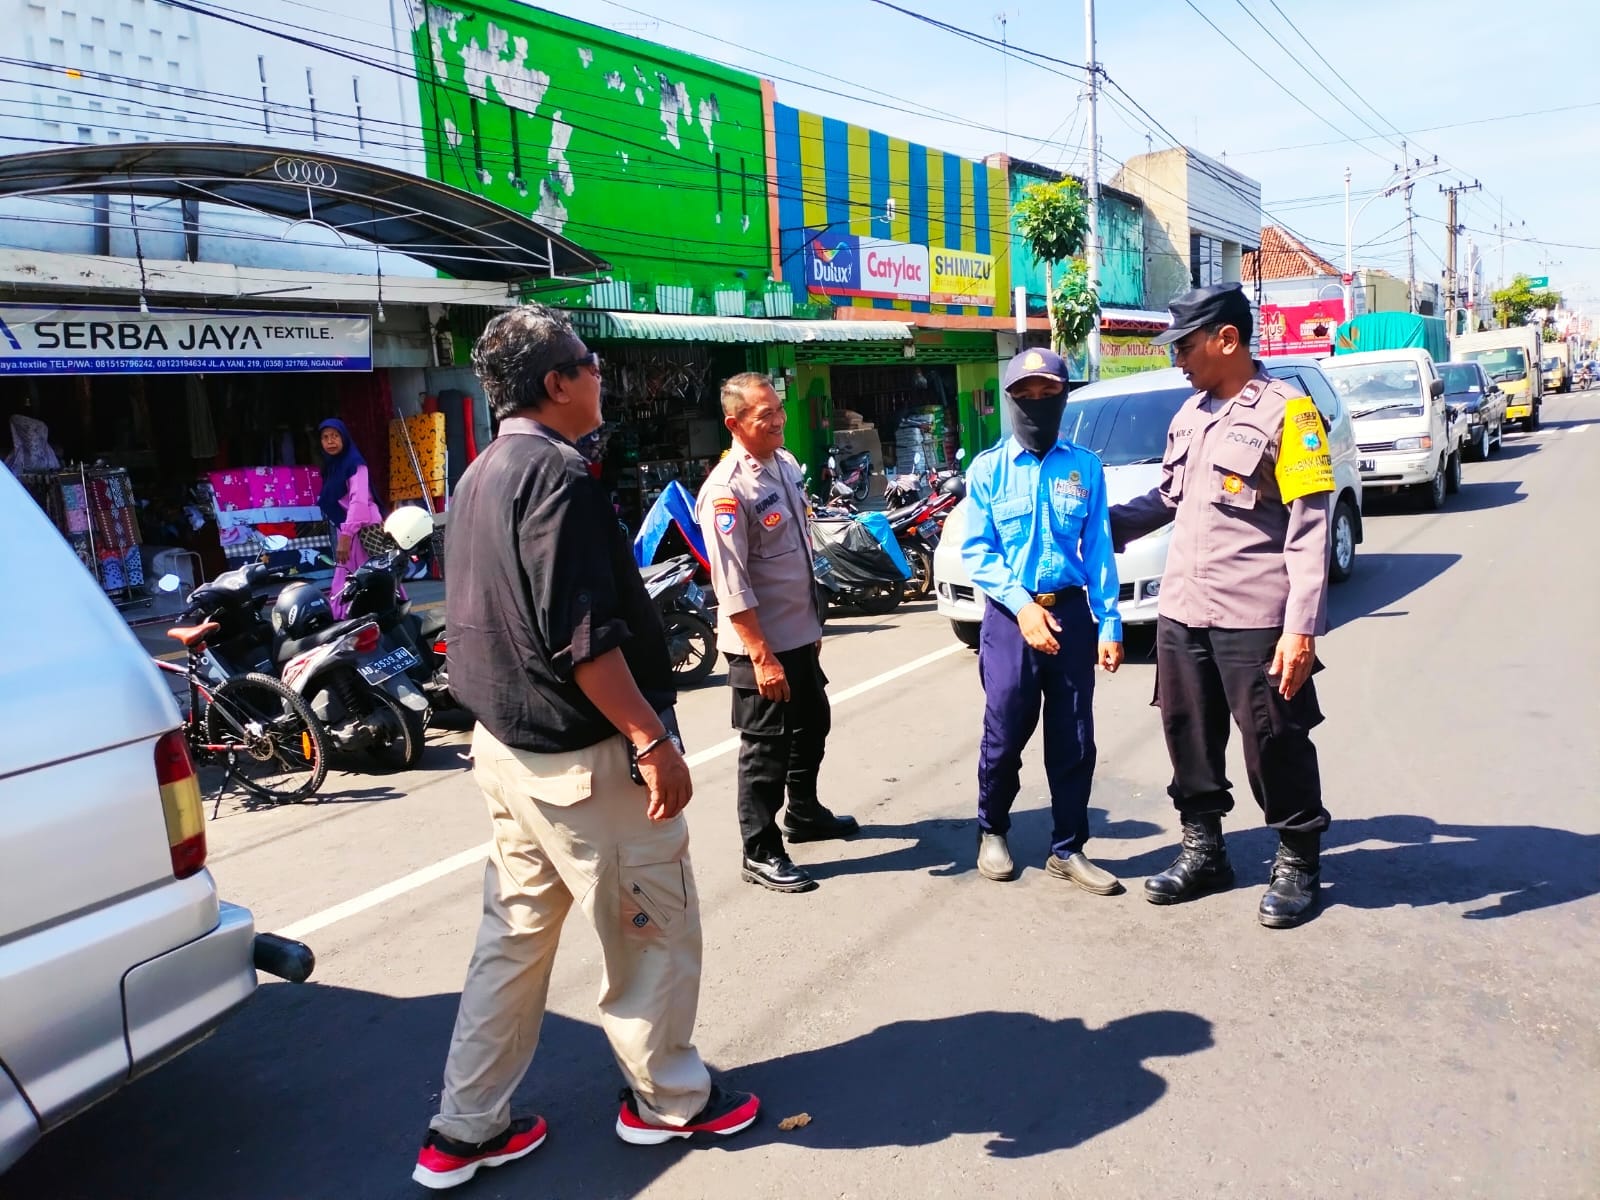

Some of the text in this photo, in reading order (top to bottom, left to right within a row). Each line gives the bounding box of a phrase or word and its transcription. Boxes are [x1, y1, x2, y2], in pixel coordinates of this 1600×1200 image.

[814, 258, 849, 283] Dulux
[867, 251, 922, 288] Catylac
[935, 255, 991, 280] SHIMIZU
[34, 321, 335, 351] SERBA JAYA TEXTILE.
[50, 360, 94, 369] TELP/WA:
[310, 359, 344, 368] NGANJUK
[374, 655, 396, 670] 3539
